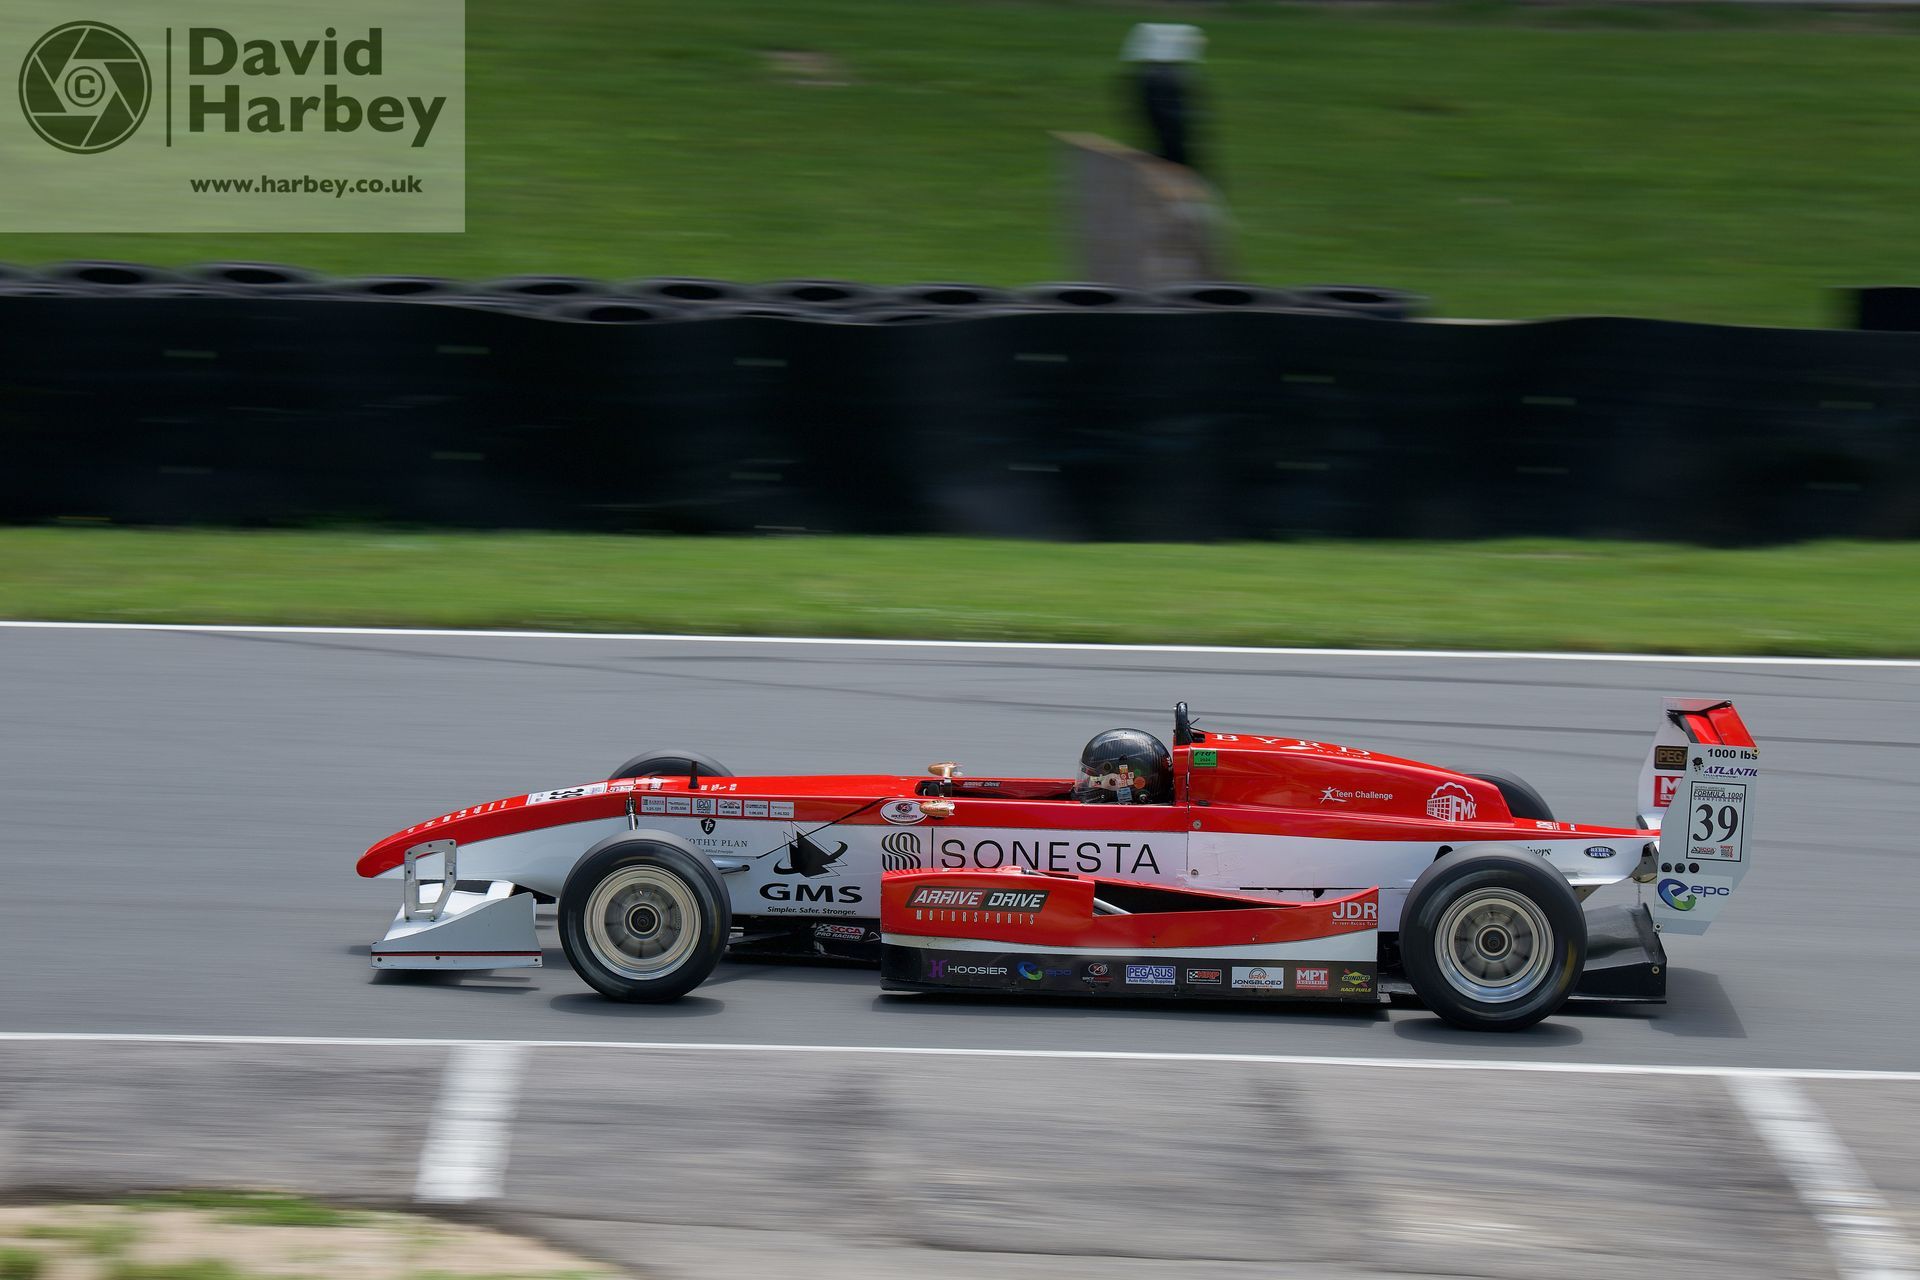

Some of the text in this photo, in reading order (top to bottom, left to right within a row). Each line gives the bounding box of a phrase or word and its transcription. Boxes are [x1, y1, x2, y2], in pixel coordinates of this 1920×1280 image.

[1661, 750, 1685, 763] PEG
[1707, 748, 1758, 760] 1000 lbs
[1335, 790, 1394, 800] Teen Challenge
[1452, 795, 1477, 822] FMX
[1692, 803, 1739, 843] 39
[721, 839, 748, 848] PLAN
[941, 839, 1161, 875] SONESTA
[759, 883, 863, 904] GMS
[1690, 885, 1730, 898] epc
[914, 889, 1045, 908] ARRIVE DRIVE
[767, 906, 798, 914] Simpler.
[822, 907, 857, 915] Stronger.
[1332, 901, 1377, 919] JDR
[916, 909, 1034, 925] MOTORSPORTS
[831, 925, 862, 934] SCCA
[832, 932, 861, 940] RACING
[947, 965, 1008, 975] HOOSIER
[1129, 966, 1173, 979] PEGASUS
[1296, 969, 1328, 981] MPT
